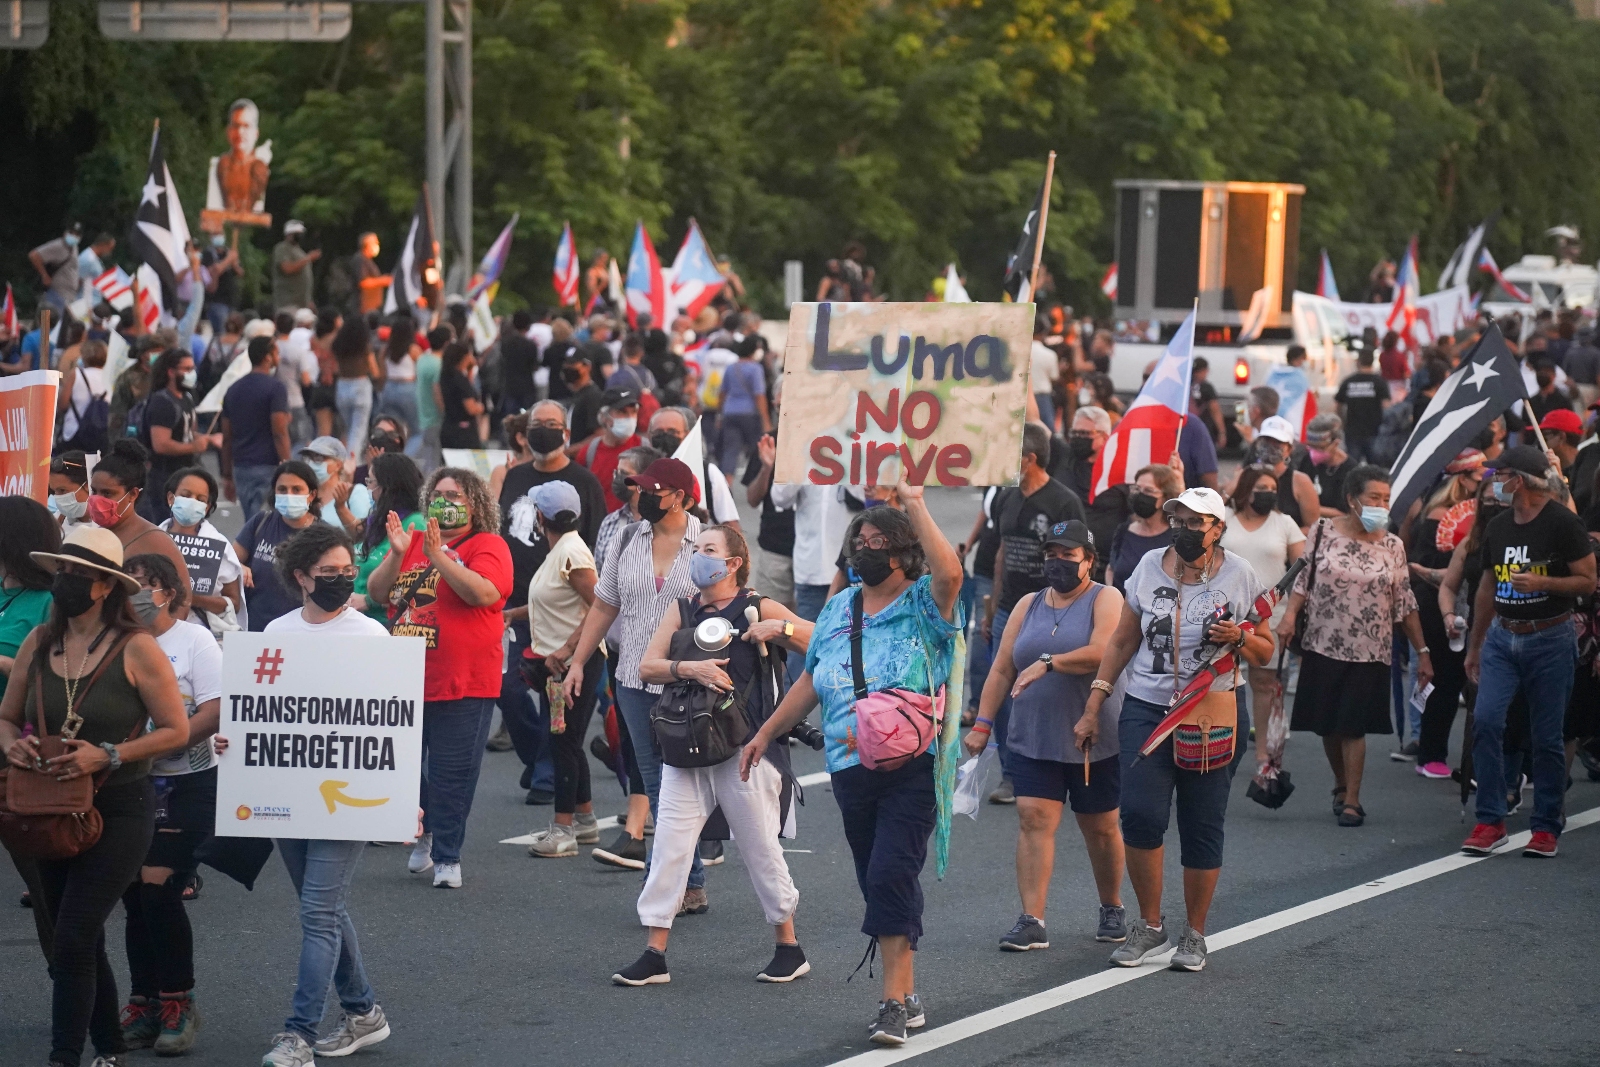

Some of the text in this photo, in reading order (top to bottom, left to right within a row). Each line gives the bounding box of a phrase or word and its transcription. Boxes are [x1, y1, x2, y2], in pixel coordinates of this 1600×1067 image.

[811, 303, 1013, 382] Luma
[855, 388, 941, 440] NO
[1504, 545, 1531, 564] PAL
[230, 694, 415, 727] TRANSFORMACIÓN
[244, 731, 396, 771] ENERGÉTICA
